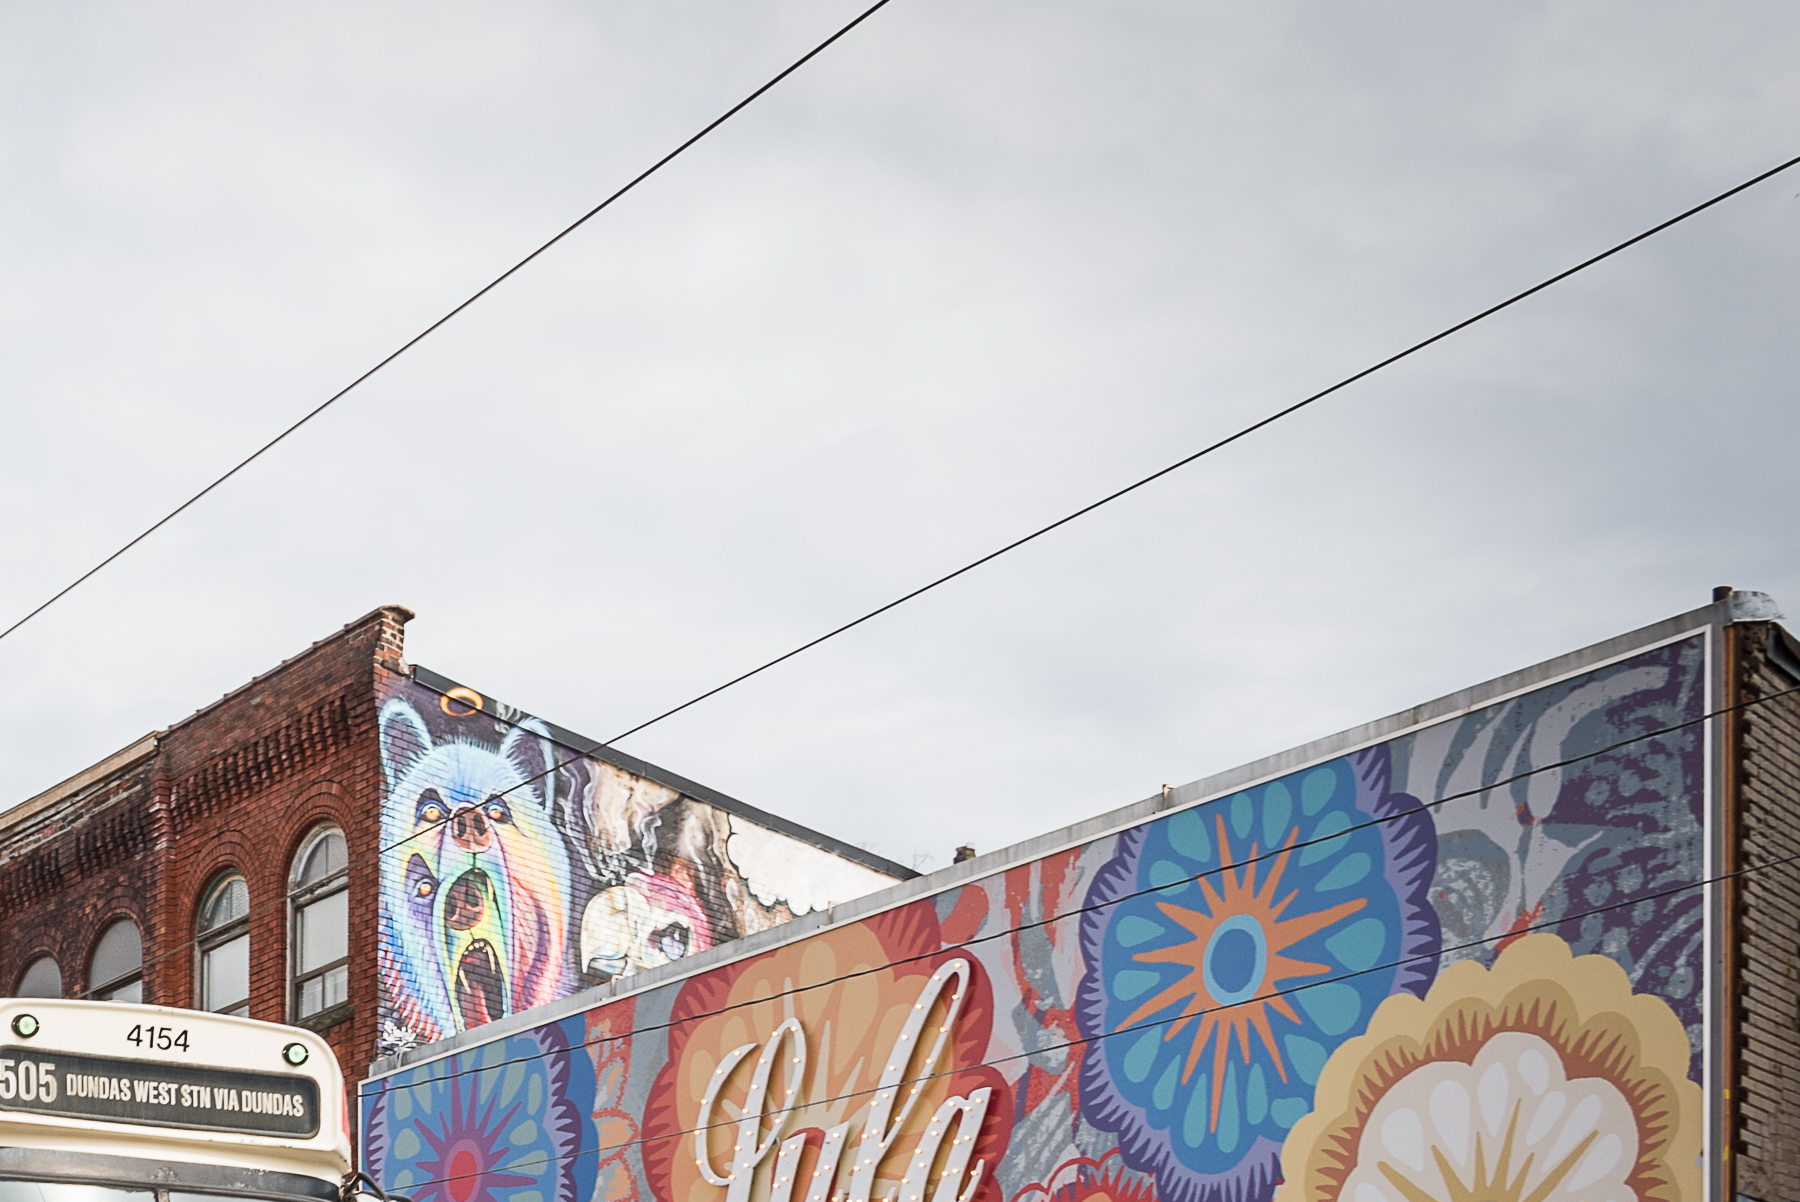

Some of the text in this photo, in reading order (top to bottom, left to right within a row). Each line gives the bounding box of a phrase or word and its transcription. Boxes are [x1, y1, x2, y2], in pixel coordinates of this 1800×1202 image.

[126, 1024, 190, 1052] 4154
[65, 1073, 131, 1102] DUNDAS
[134, 1080, 179, 1106] WEST
[181, 1084, 211, 1109] STN
[214, 1088, 240, 1112] VIA
[241, 1090, 304, 1117] DUNDAS
